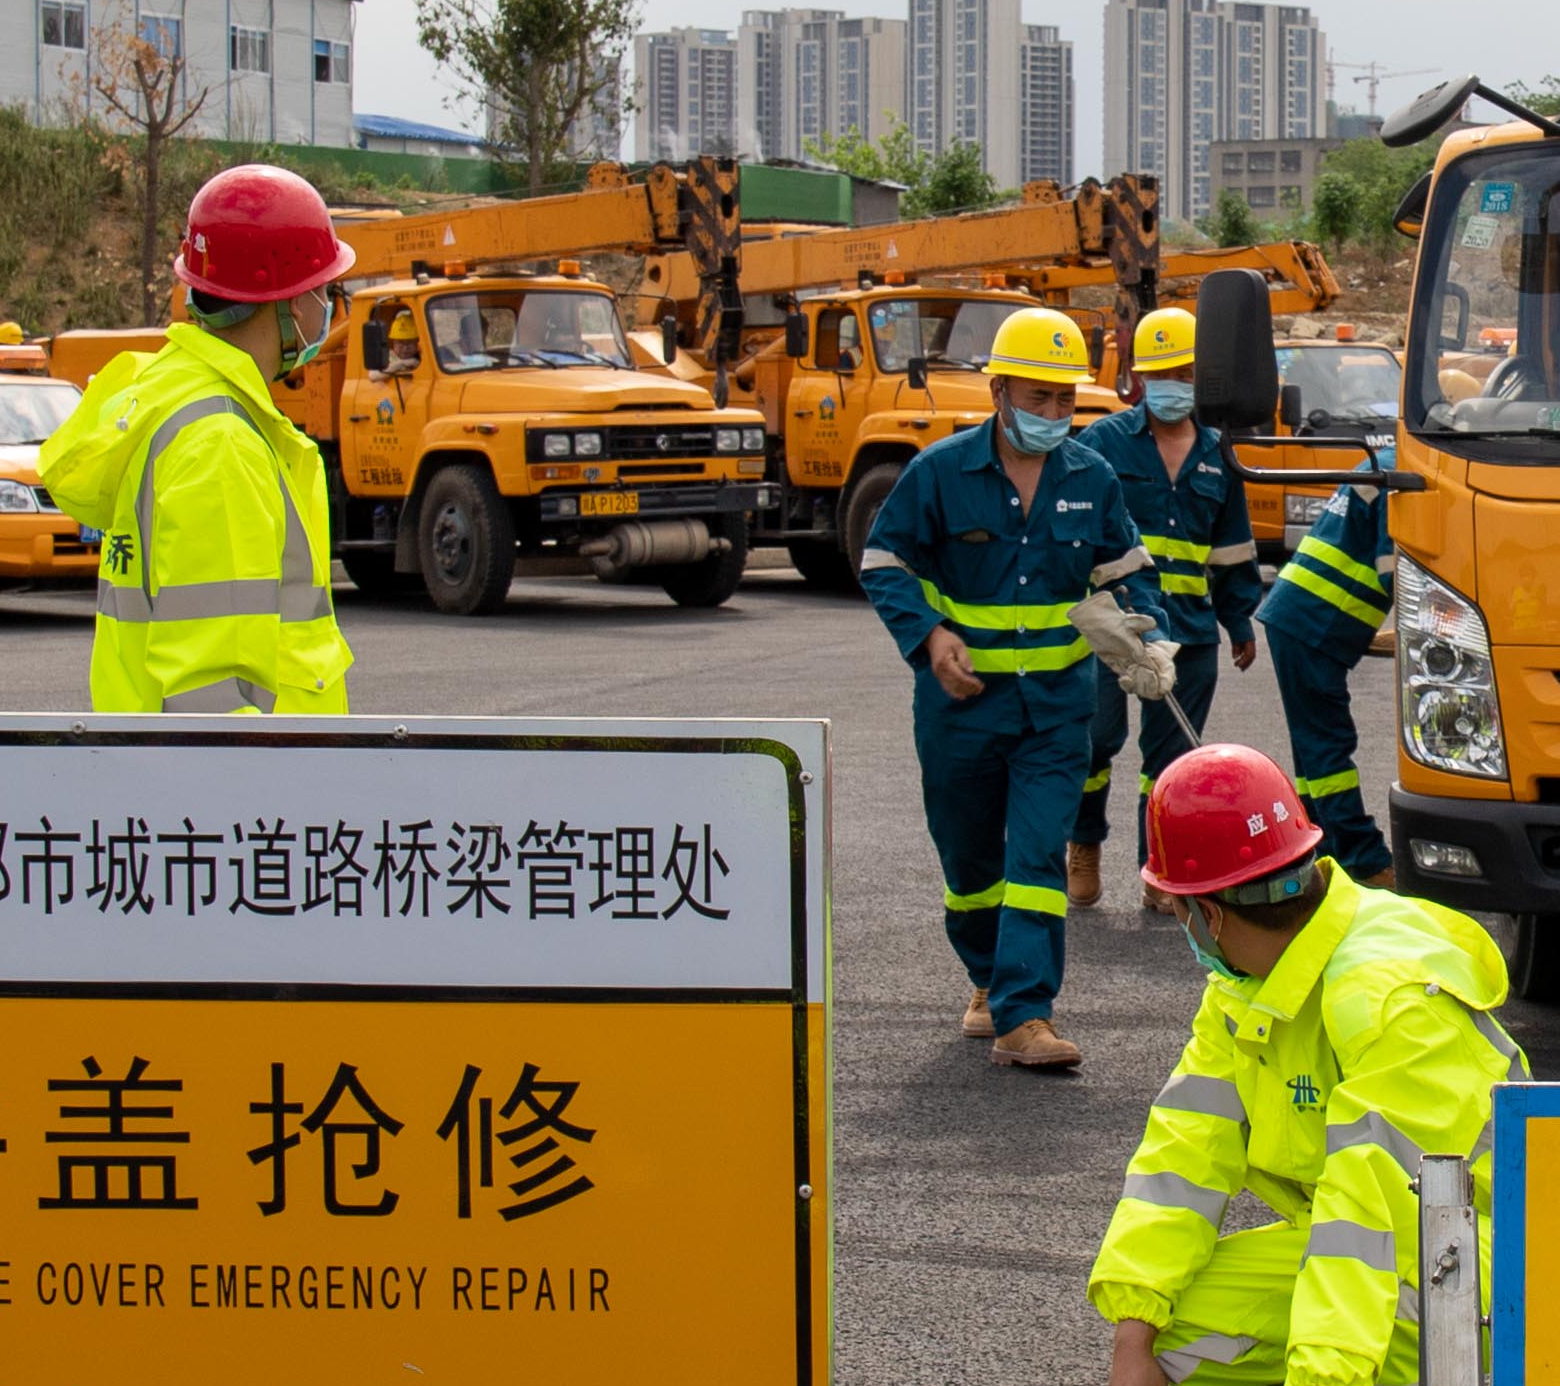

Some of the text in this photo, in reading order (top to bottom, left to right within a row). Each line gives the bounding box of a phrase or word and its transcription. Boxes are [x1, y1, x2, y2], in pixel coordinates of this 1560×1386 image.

[36, 1262, 166, 1308] COVER
[190, 1263, 427, 1311] EMERGENCY
[451, 1266, 611, 1313] REPAIR
